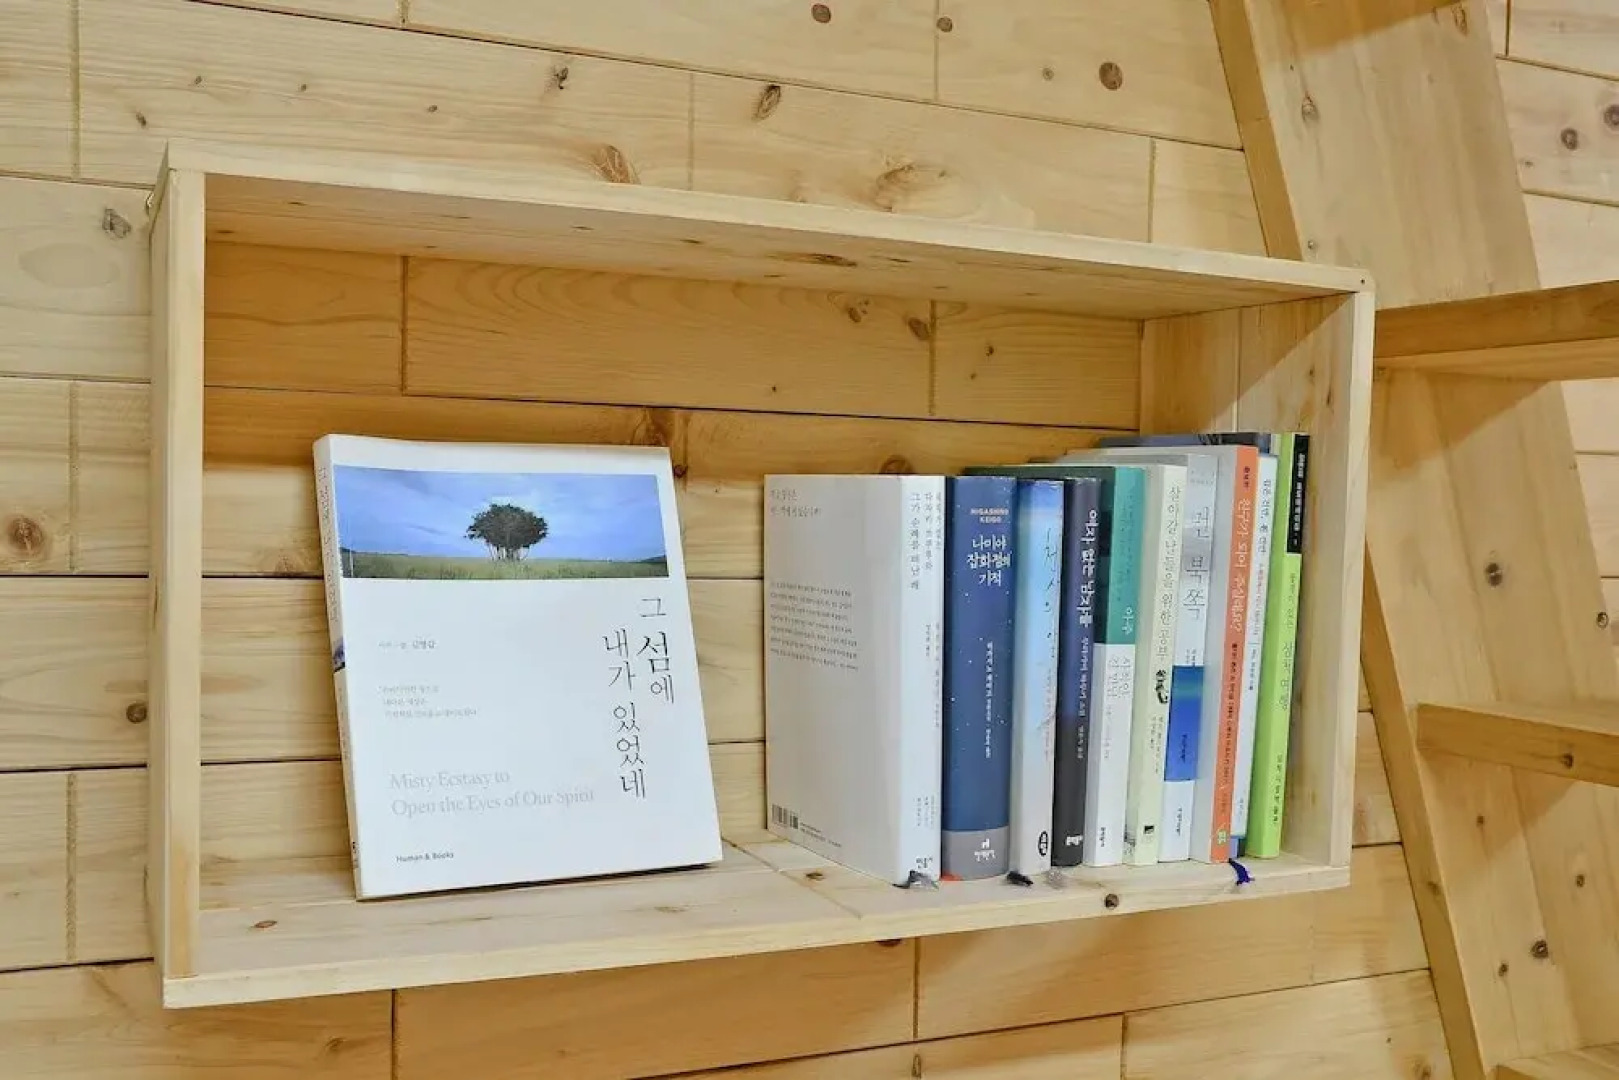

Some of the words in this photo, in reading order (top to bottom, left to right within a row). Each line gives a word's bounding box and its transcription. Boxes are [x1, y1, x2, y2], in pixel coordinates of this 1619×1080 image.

[1080, 509, 1099, 544] 여자
[1237, 499, 1251, 537] 친구가
[972, 534, 1007, 551] 나미야
[1236, 541, 1249, 569] 되어
[967, 551, 1011, 569] 잡화점의
[1082, 548, 1097, 578] 없는
[979, 570, 1002, 587] 기적
[640, 597, 667, 618] 그
[1076, 580, 1096, 628] 남자들
[1160, 593, 1173, 627] 위한
[1121, 606, 1134, 635] 아주
[602, 629, 637, 692] 내가
[1156, 629, 1169, 661] 공부
[638, 631, 675, 704] 섬에
[613, 702, 647, 799] 있었네
[390, 772, 433, 792] Misty
[437, 770, 491, 790] Ecstasy
[494, 770, 511, 783] to
[391, 798, 436, 819] Open
[440, 795, 463, 812] the
[466, 793, 501, 815] Eyes
[504, 790, 520, 807] of
[522, 789, 552, 806] Our
[554, 786, 595, 808] Spirit
[395, 851, 424, 863] Human
[424, 851, 430, 861] &
[431, 850, 455, 861] Books
